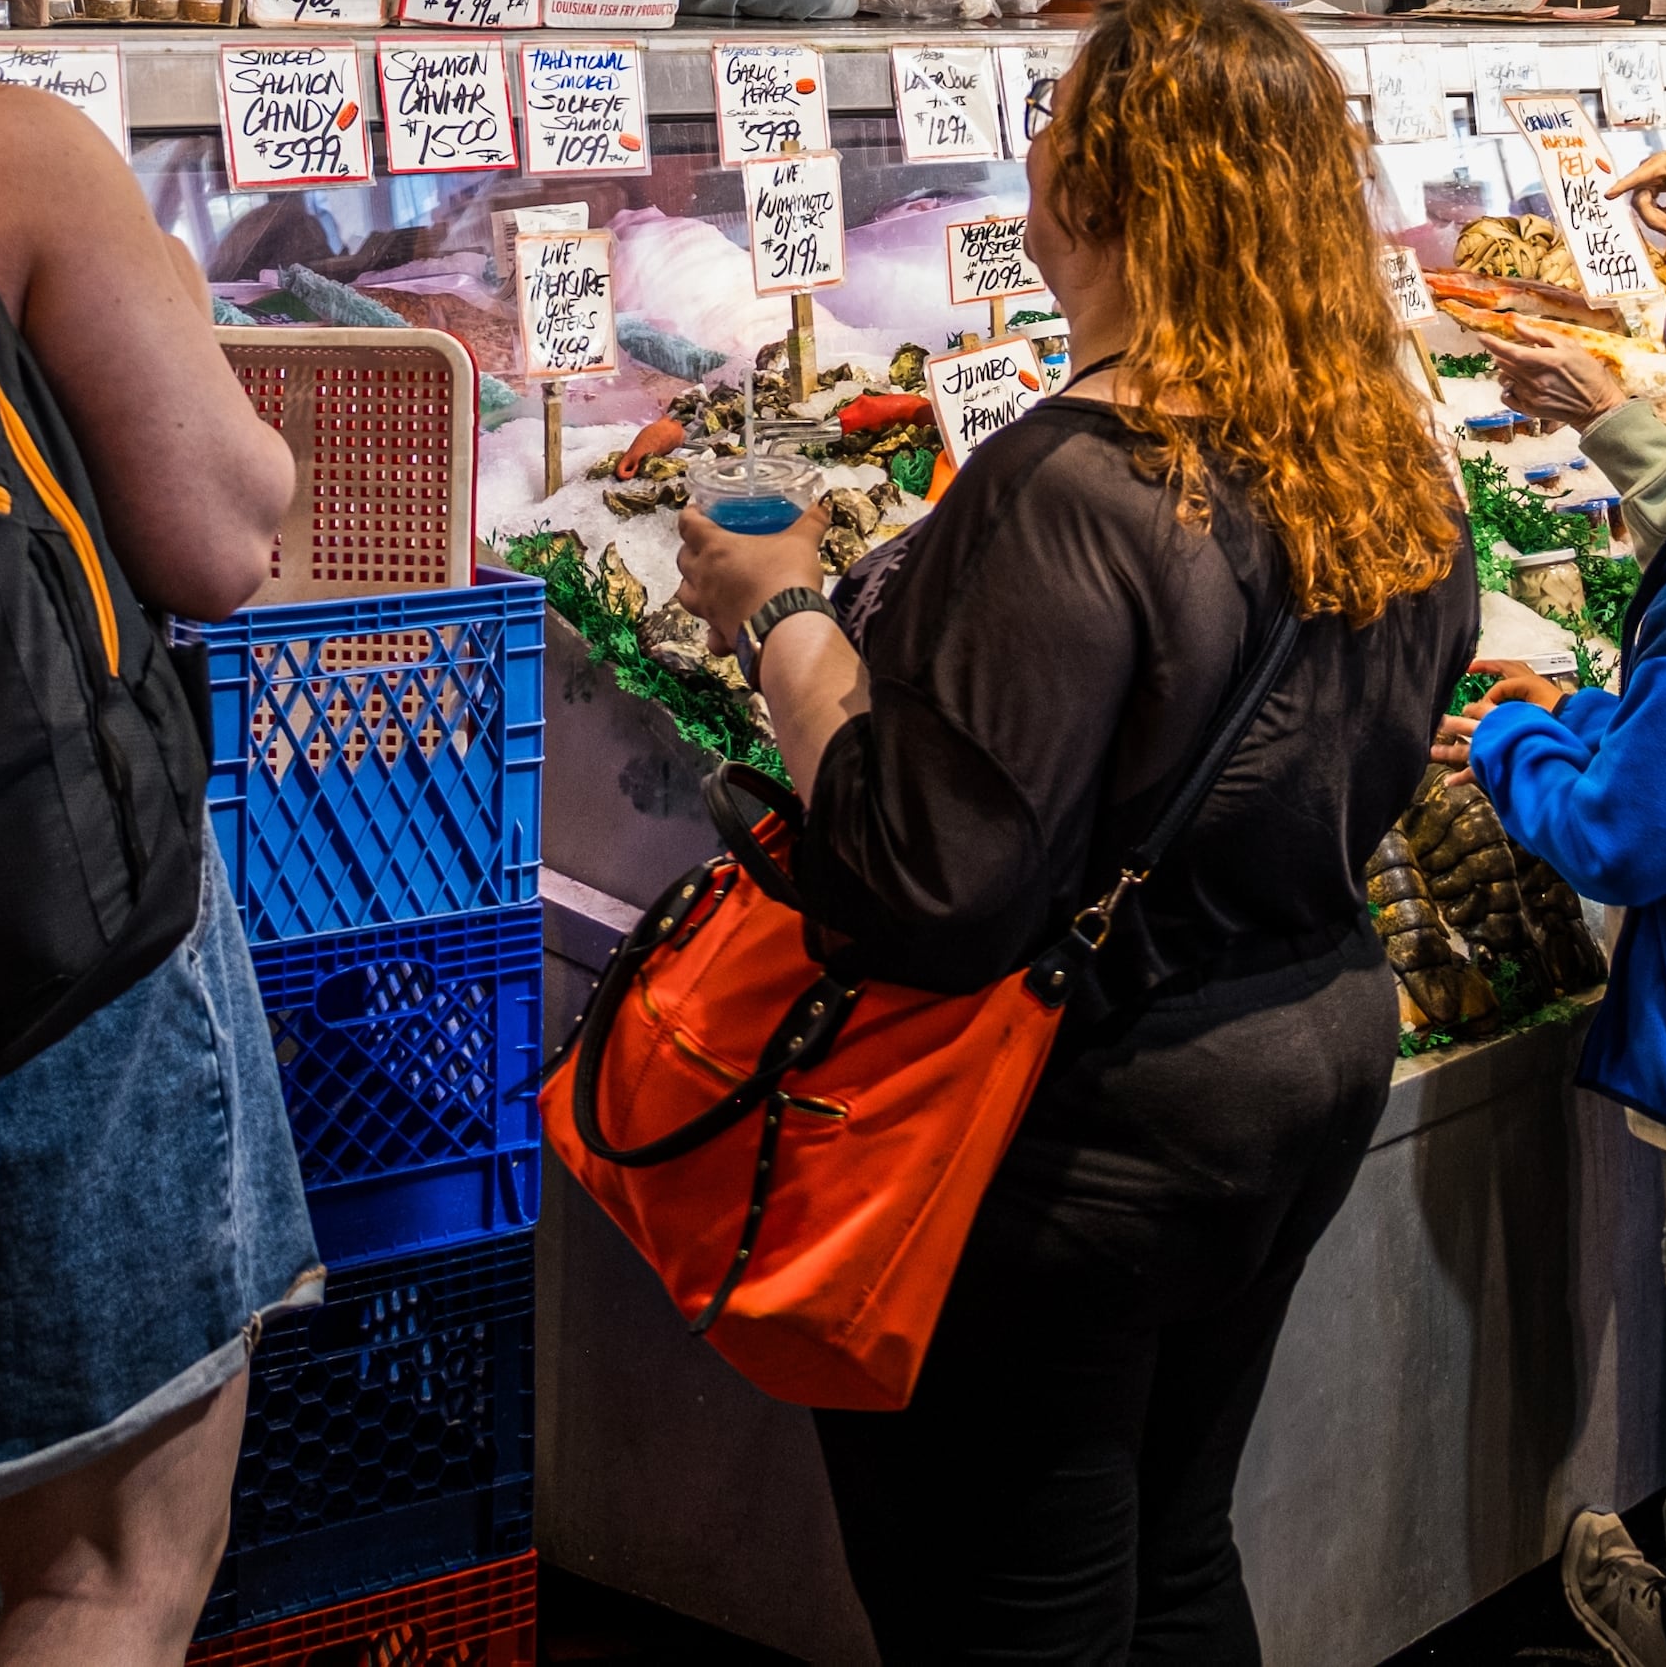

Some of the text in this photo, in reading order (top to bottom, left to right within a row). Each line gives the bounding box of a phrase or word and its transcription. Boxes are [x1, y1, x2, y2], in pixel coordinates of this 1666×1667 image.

[551, 0, 597, 15] LOUISIANA
[600, 2, 619, 16] FISH
[621, 3, 636, 16] FRY
[228, 47, 326, 67] SMOKED
[384, 40, 493, 82] SALMON
[527, 47, 634, 73] TRADITIONAL
[726, 56, 778, 85] GARLIC
[229, 58, 347, 96] SALMON
[531, 73, 621, 92] SMOKED
[944, 65, 981, 90] SOLE
[399, 78, 495, 117] CAVIAR
[528, 94, 630, 113] SOCKEYE
[740, 80, 801, 108] PEPPER
[242, 96, 344, 137] CANDY
[540, 110, 627, 134] SALMON
[1518, 101, 1574, 132] GENUINE
[1540, 127, 1588, 151] ALASKAN
[1556, 150, 1594, 176] RED
[755, 186, 833, 222] KUMAMOTO
[1562, 176, 1600, 208] KING
[774, 211, 826, 240] OYSTERS
[1570, 202, 1613, 230] CRAB
[966, 236, 1022, 262] OYSTER
[1585, 230, 1626, 256] LEGS
[524, 267, 611, 302] TREASURE
[545, 295, 580, 318] COVE
[536, 310, 598, 341] OYSTERS
[942, 355, 1017, 395] JUMBO
